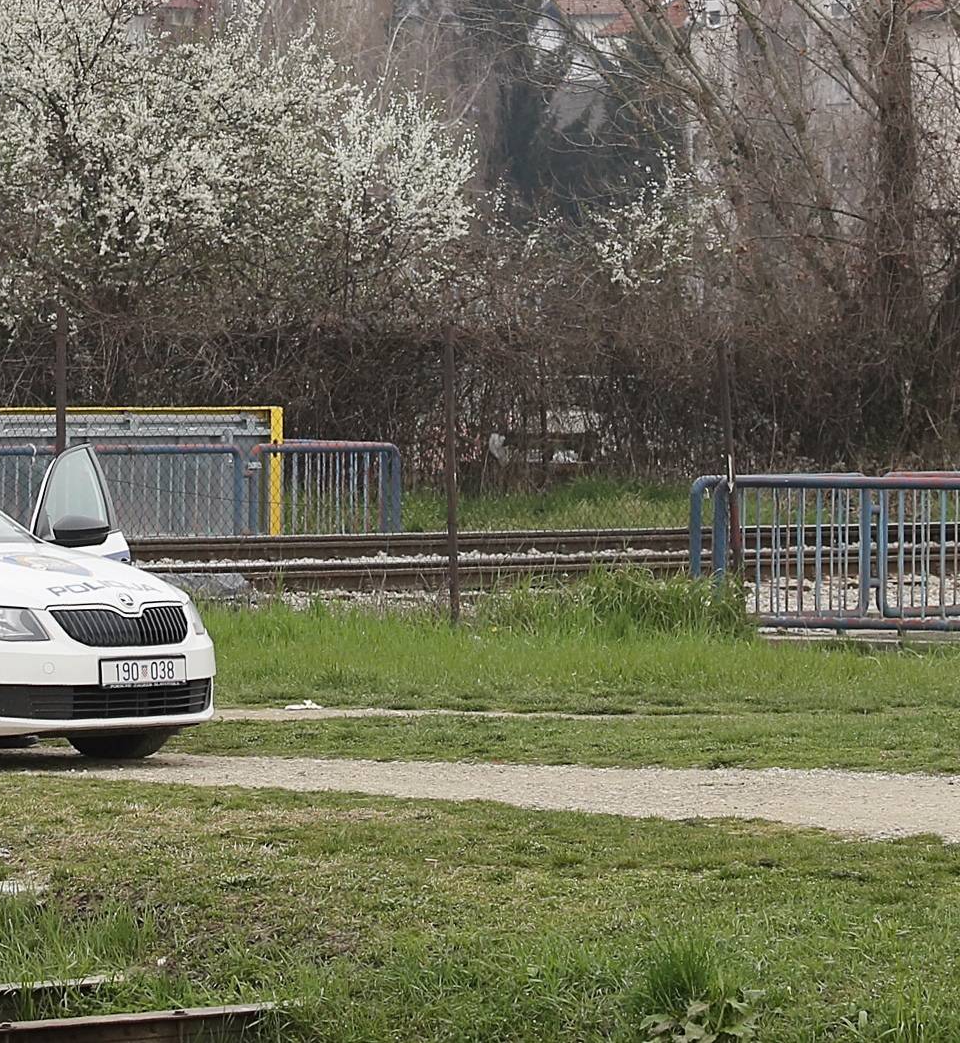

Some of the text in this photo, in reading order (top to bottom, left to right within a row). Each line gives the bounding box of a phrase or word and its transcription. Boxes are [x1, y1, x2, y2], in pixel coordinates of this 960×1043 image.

[46, 580, 163, 597] POLICIJA
[116, 660, 174, 682] 190 038
